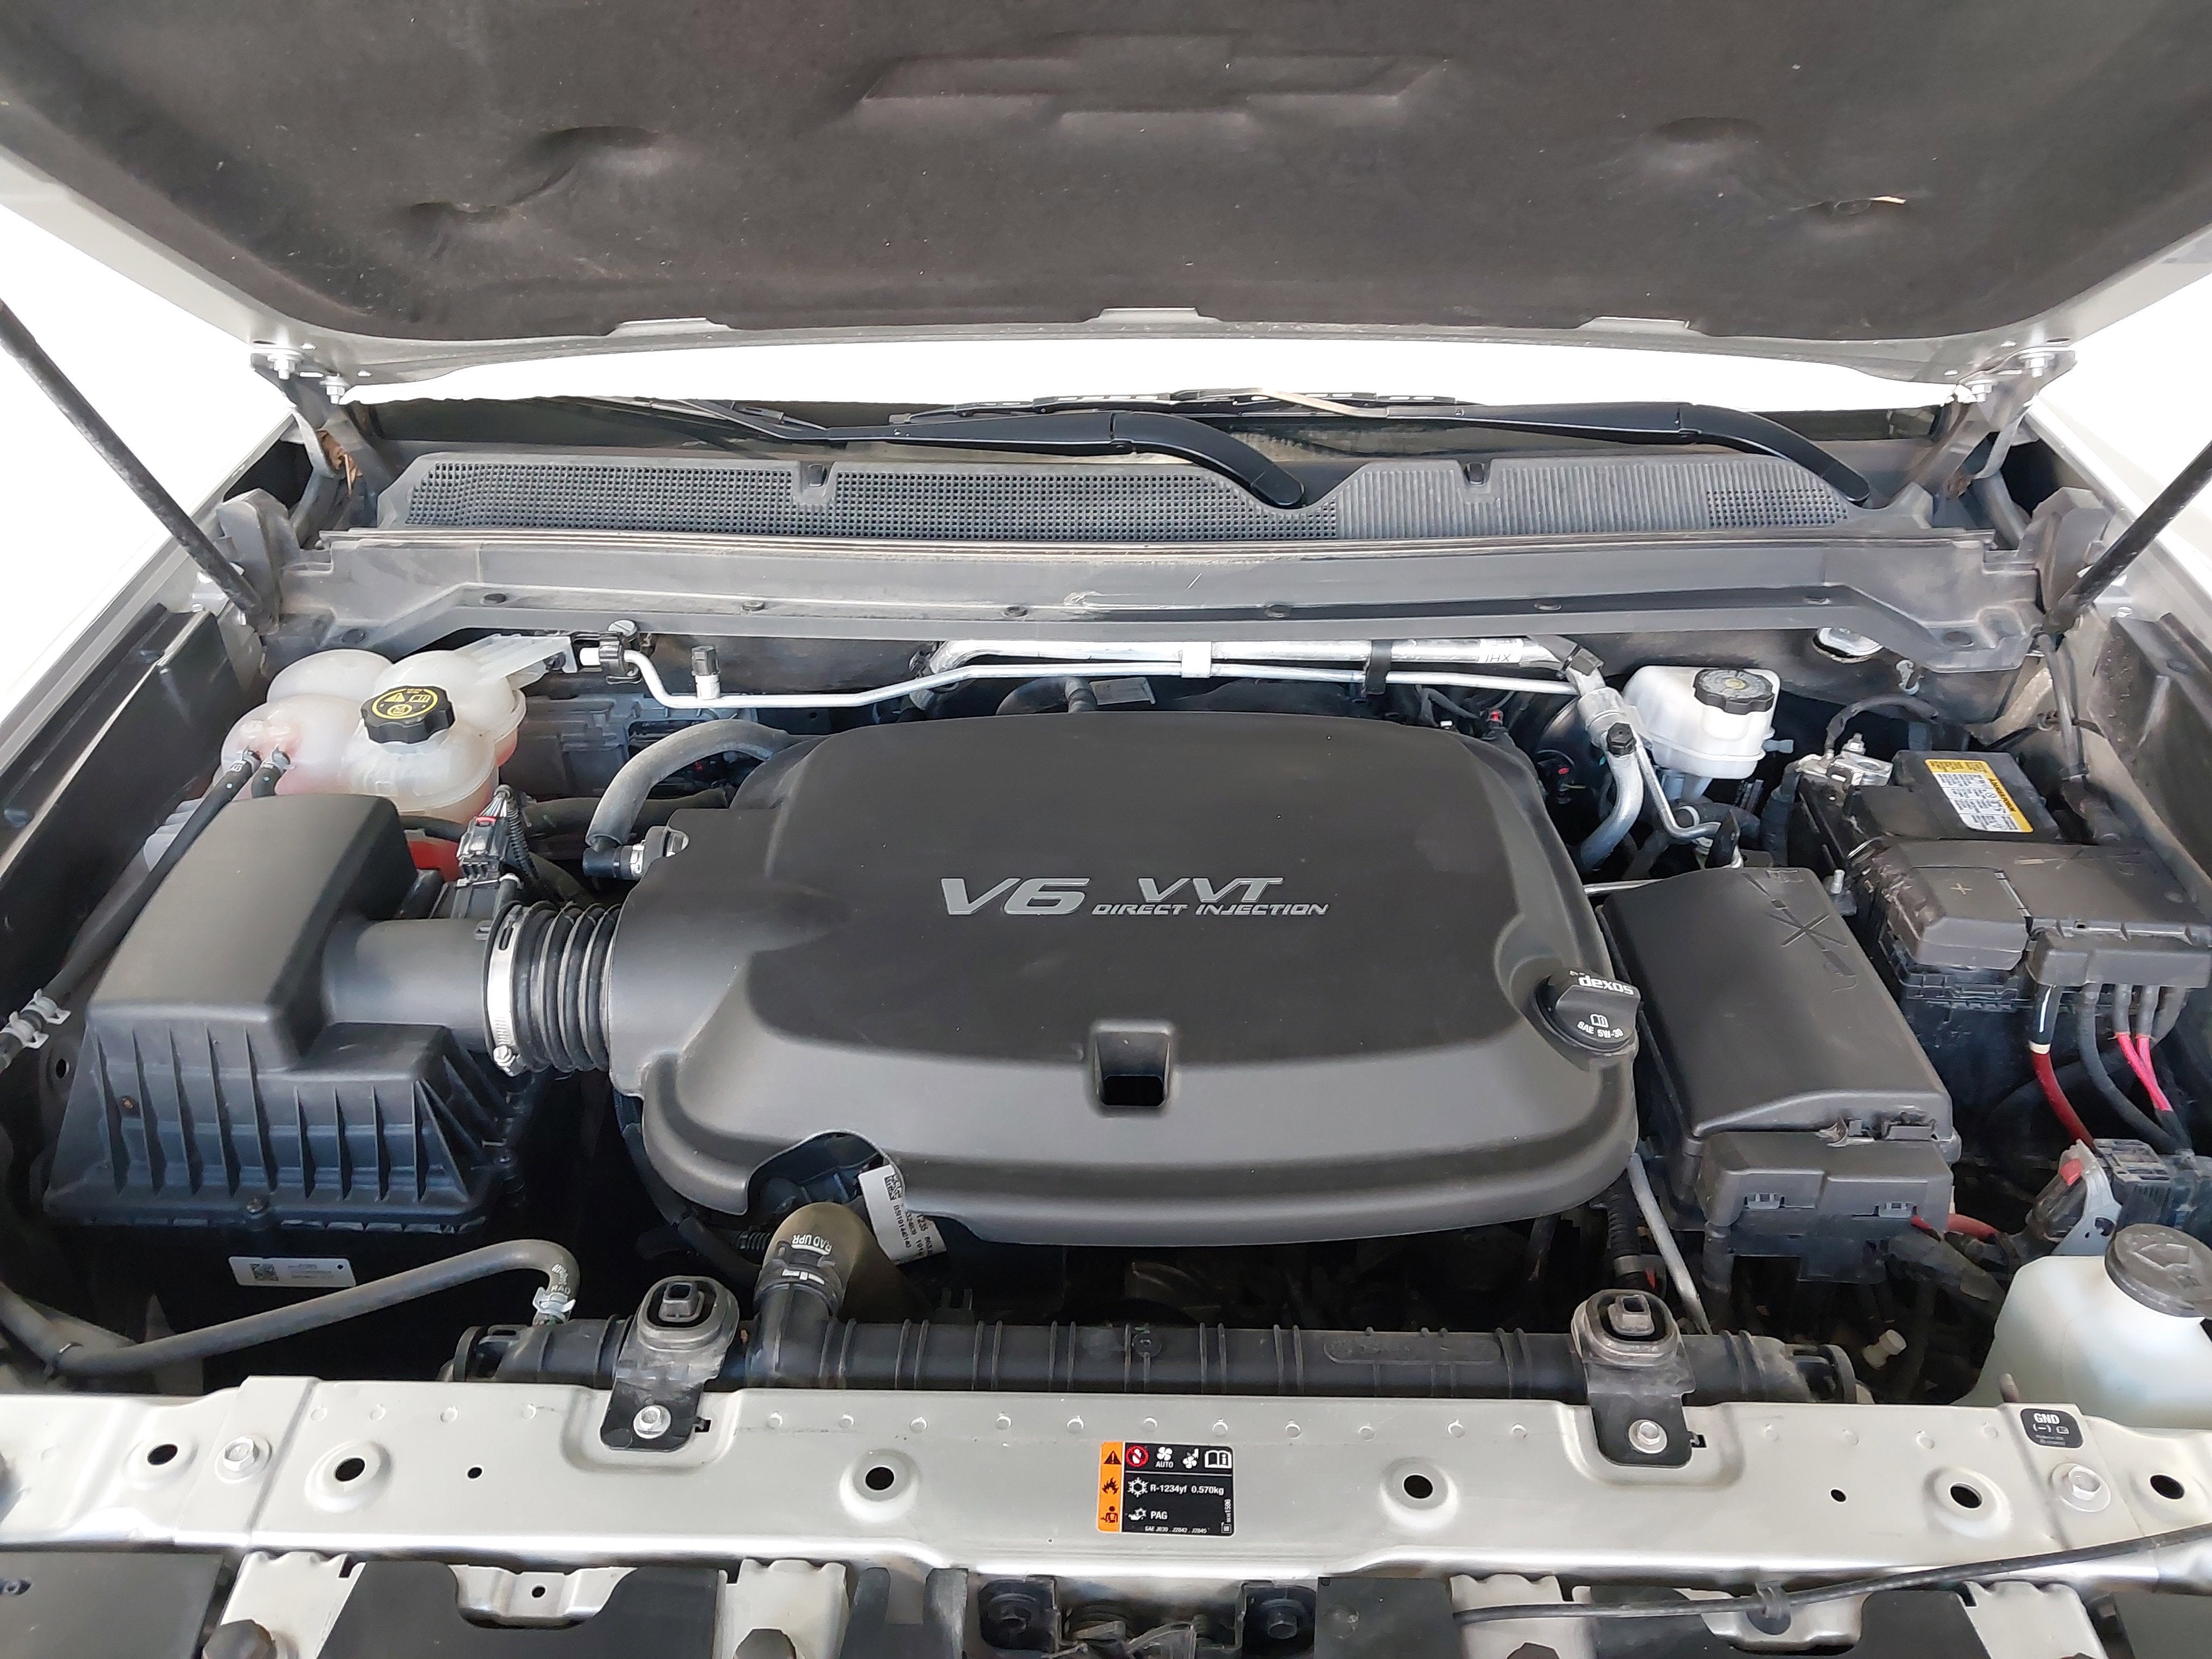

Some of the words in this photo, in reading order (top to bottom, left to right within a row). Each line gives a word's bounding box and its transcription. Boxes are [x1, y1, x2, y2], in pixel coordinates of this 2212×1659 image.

[941, 878, 1090, 915] V6
[1137, 877, 1284, 902] VVT
[1091, 903, 1188, 915] DIRECT
[1194, 903, 1329, 916] INJECTION
[1578, 975, 1635, 995] dexos
[1577, 1021, 1594, 1035] SAE
[1597, 1028, 1624, 1038] 5W-30
[792, 1234, 812, 1245] UPR
[813, 1236, 832, 1252] RAD
[551, 1285, 571, 1295] RAD
[2034, 1413, 2060, 1424] GND
[1150, 1484, 1187, 1495] R-1234yf
[1150, 1511, 1168, 1520] PAG
